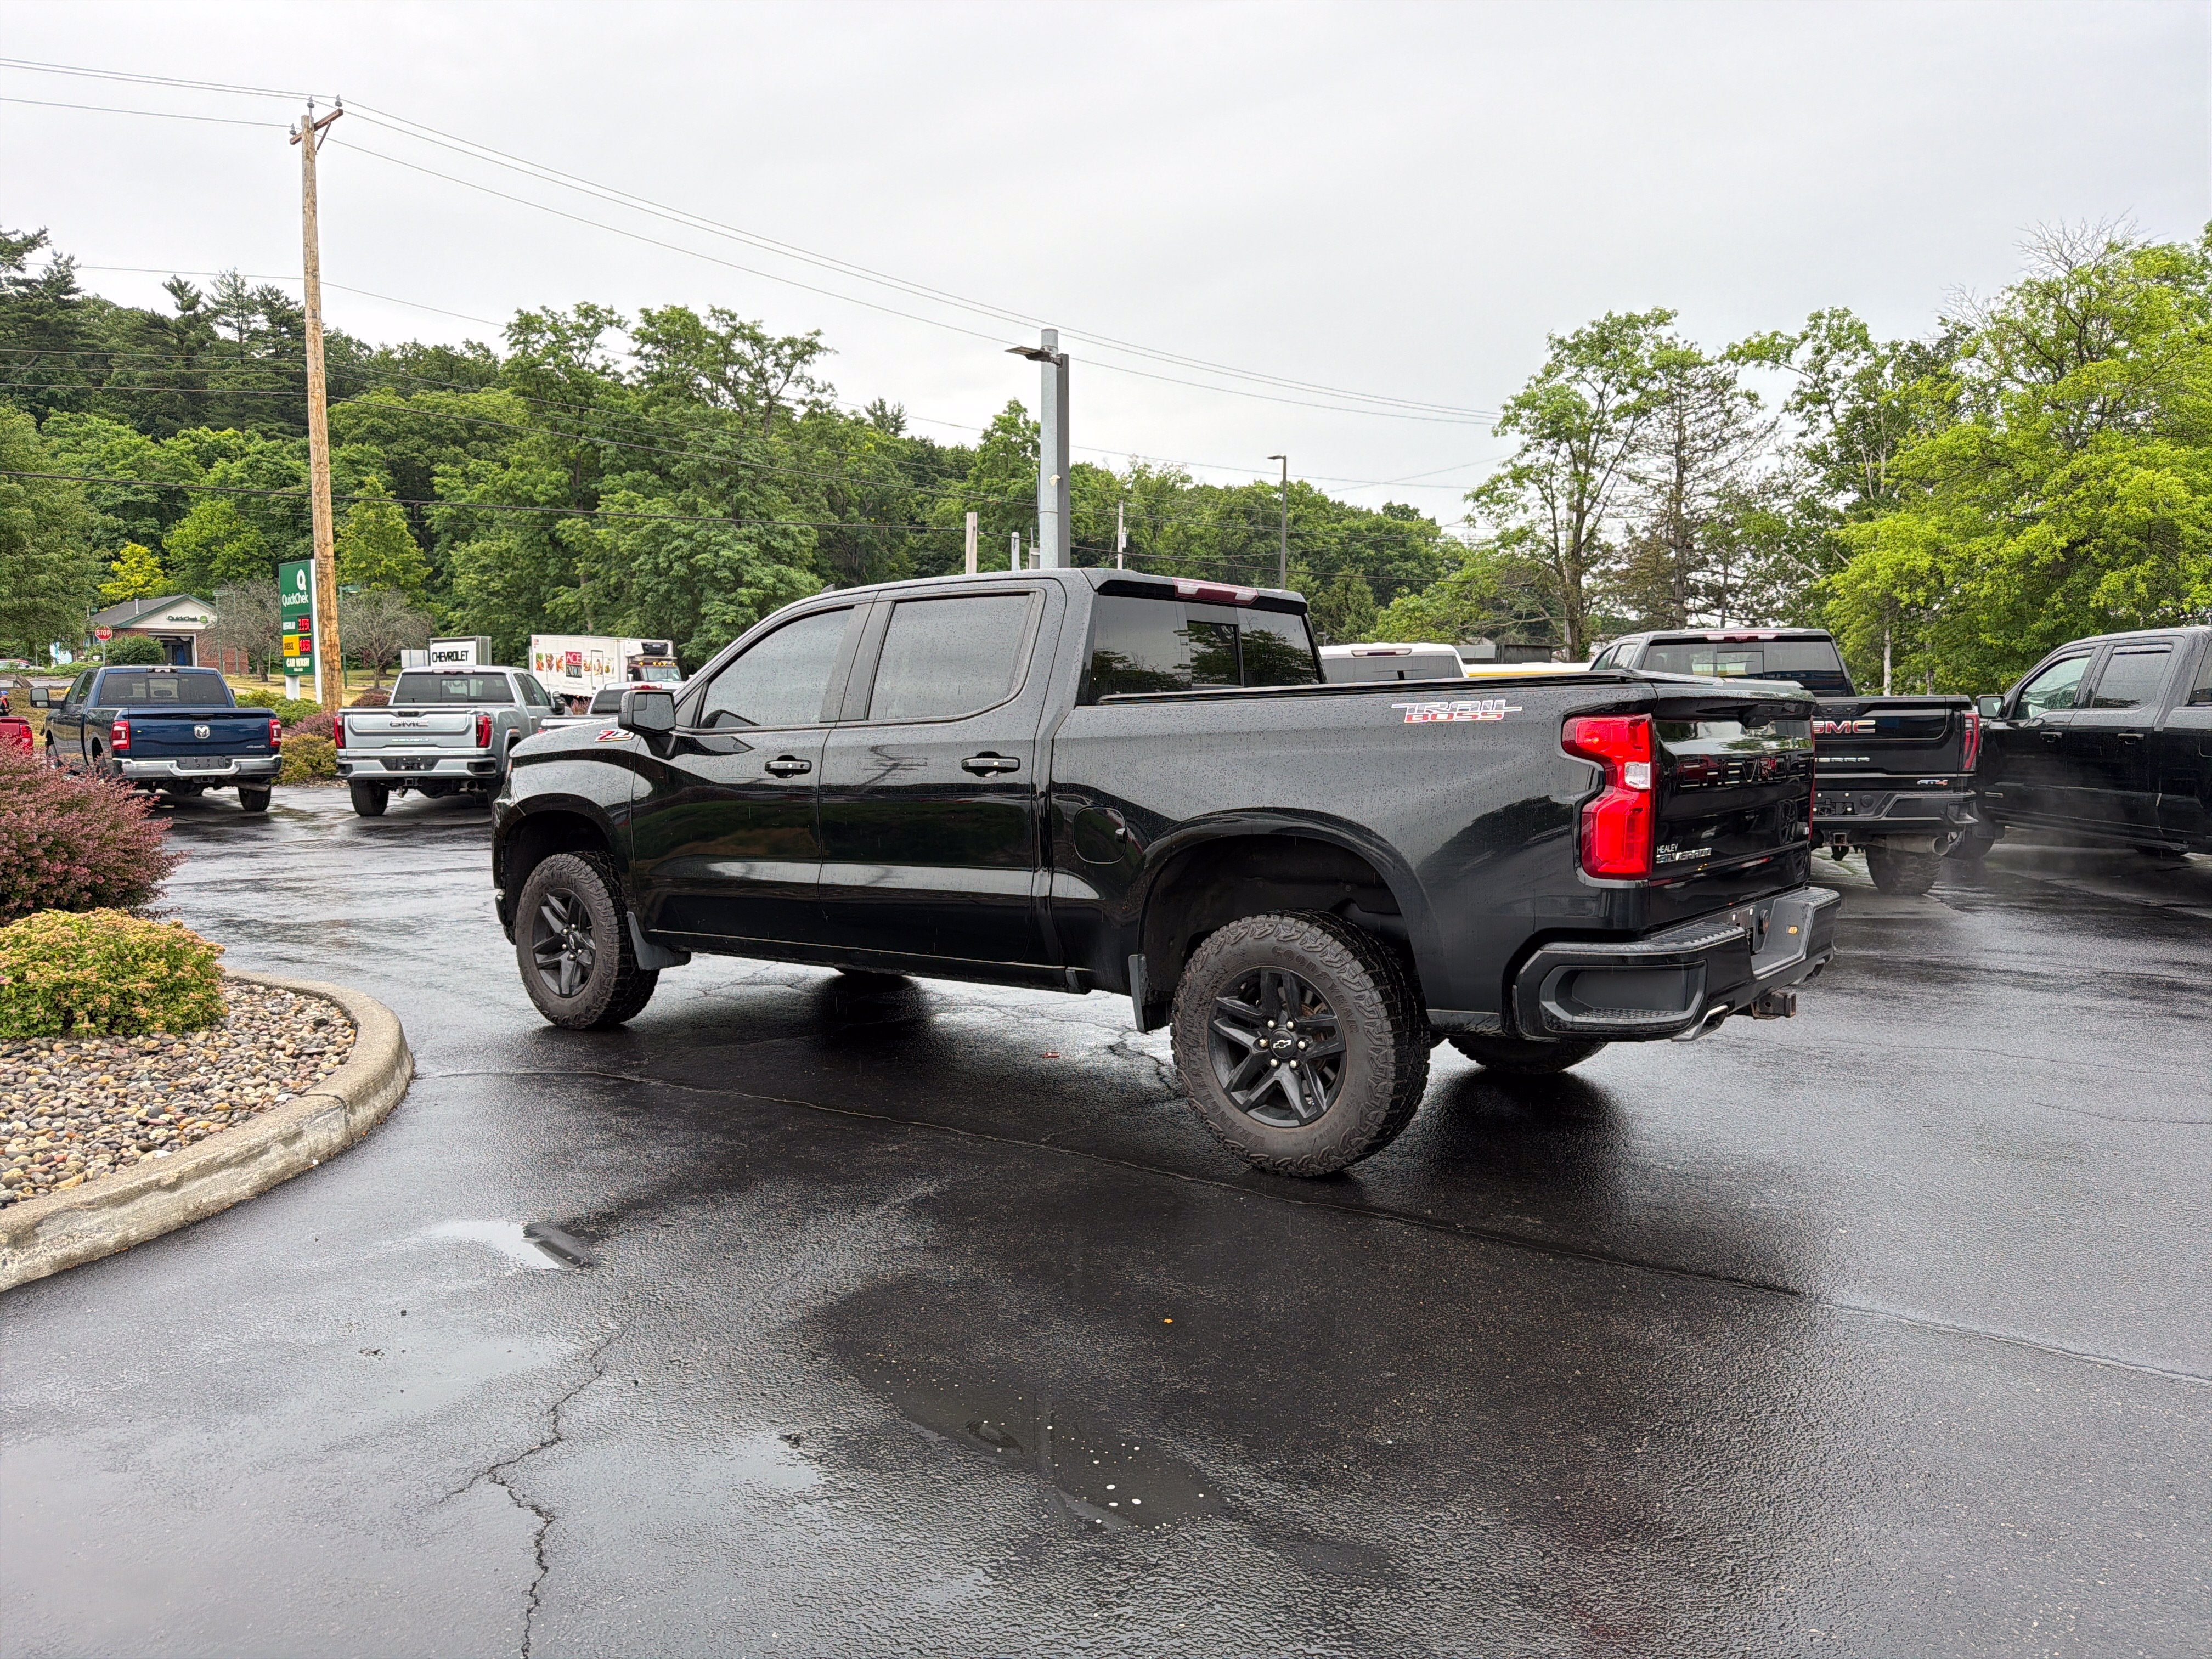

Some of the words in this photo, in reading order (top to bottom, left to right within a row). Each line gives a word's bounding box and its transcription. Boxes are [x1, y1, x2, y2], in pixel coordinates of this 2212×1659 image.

[281, 592, 309, 607] QuickChek
[286, 658, 296, 667] CAR
[296, 658, 310, 667] WASH
[432, 650, 469, 663] CHEVROLET
[566, 653, 582, 663] ACE
[1391, 699, 1522, 714] TRAIL
[390, 719, 428, 727] GMC
[1404, 711, 1505, 723] BOSS
[1679, 755, 1814, 788] CHEVROLE
[1657, 843, 1679, 854] HEALEY
[1656, 847, 1712, 864] SILVERADO
[1271, 945, 1360, 1034] GOODYEAR
